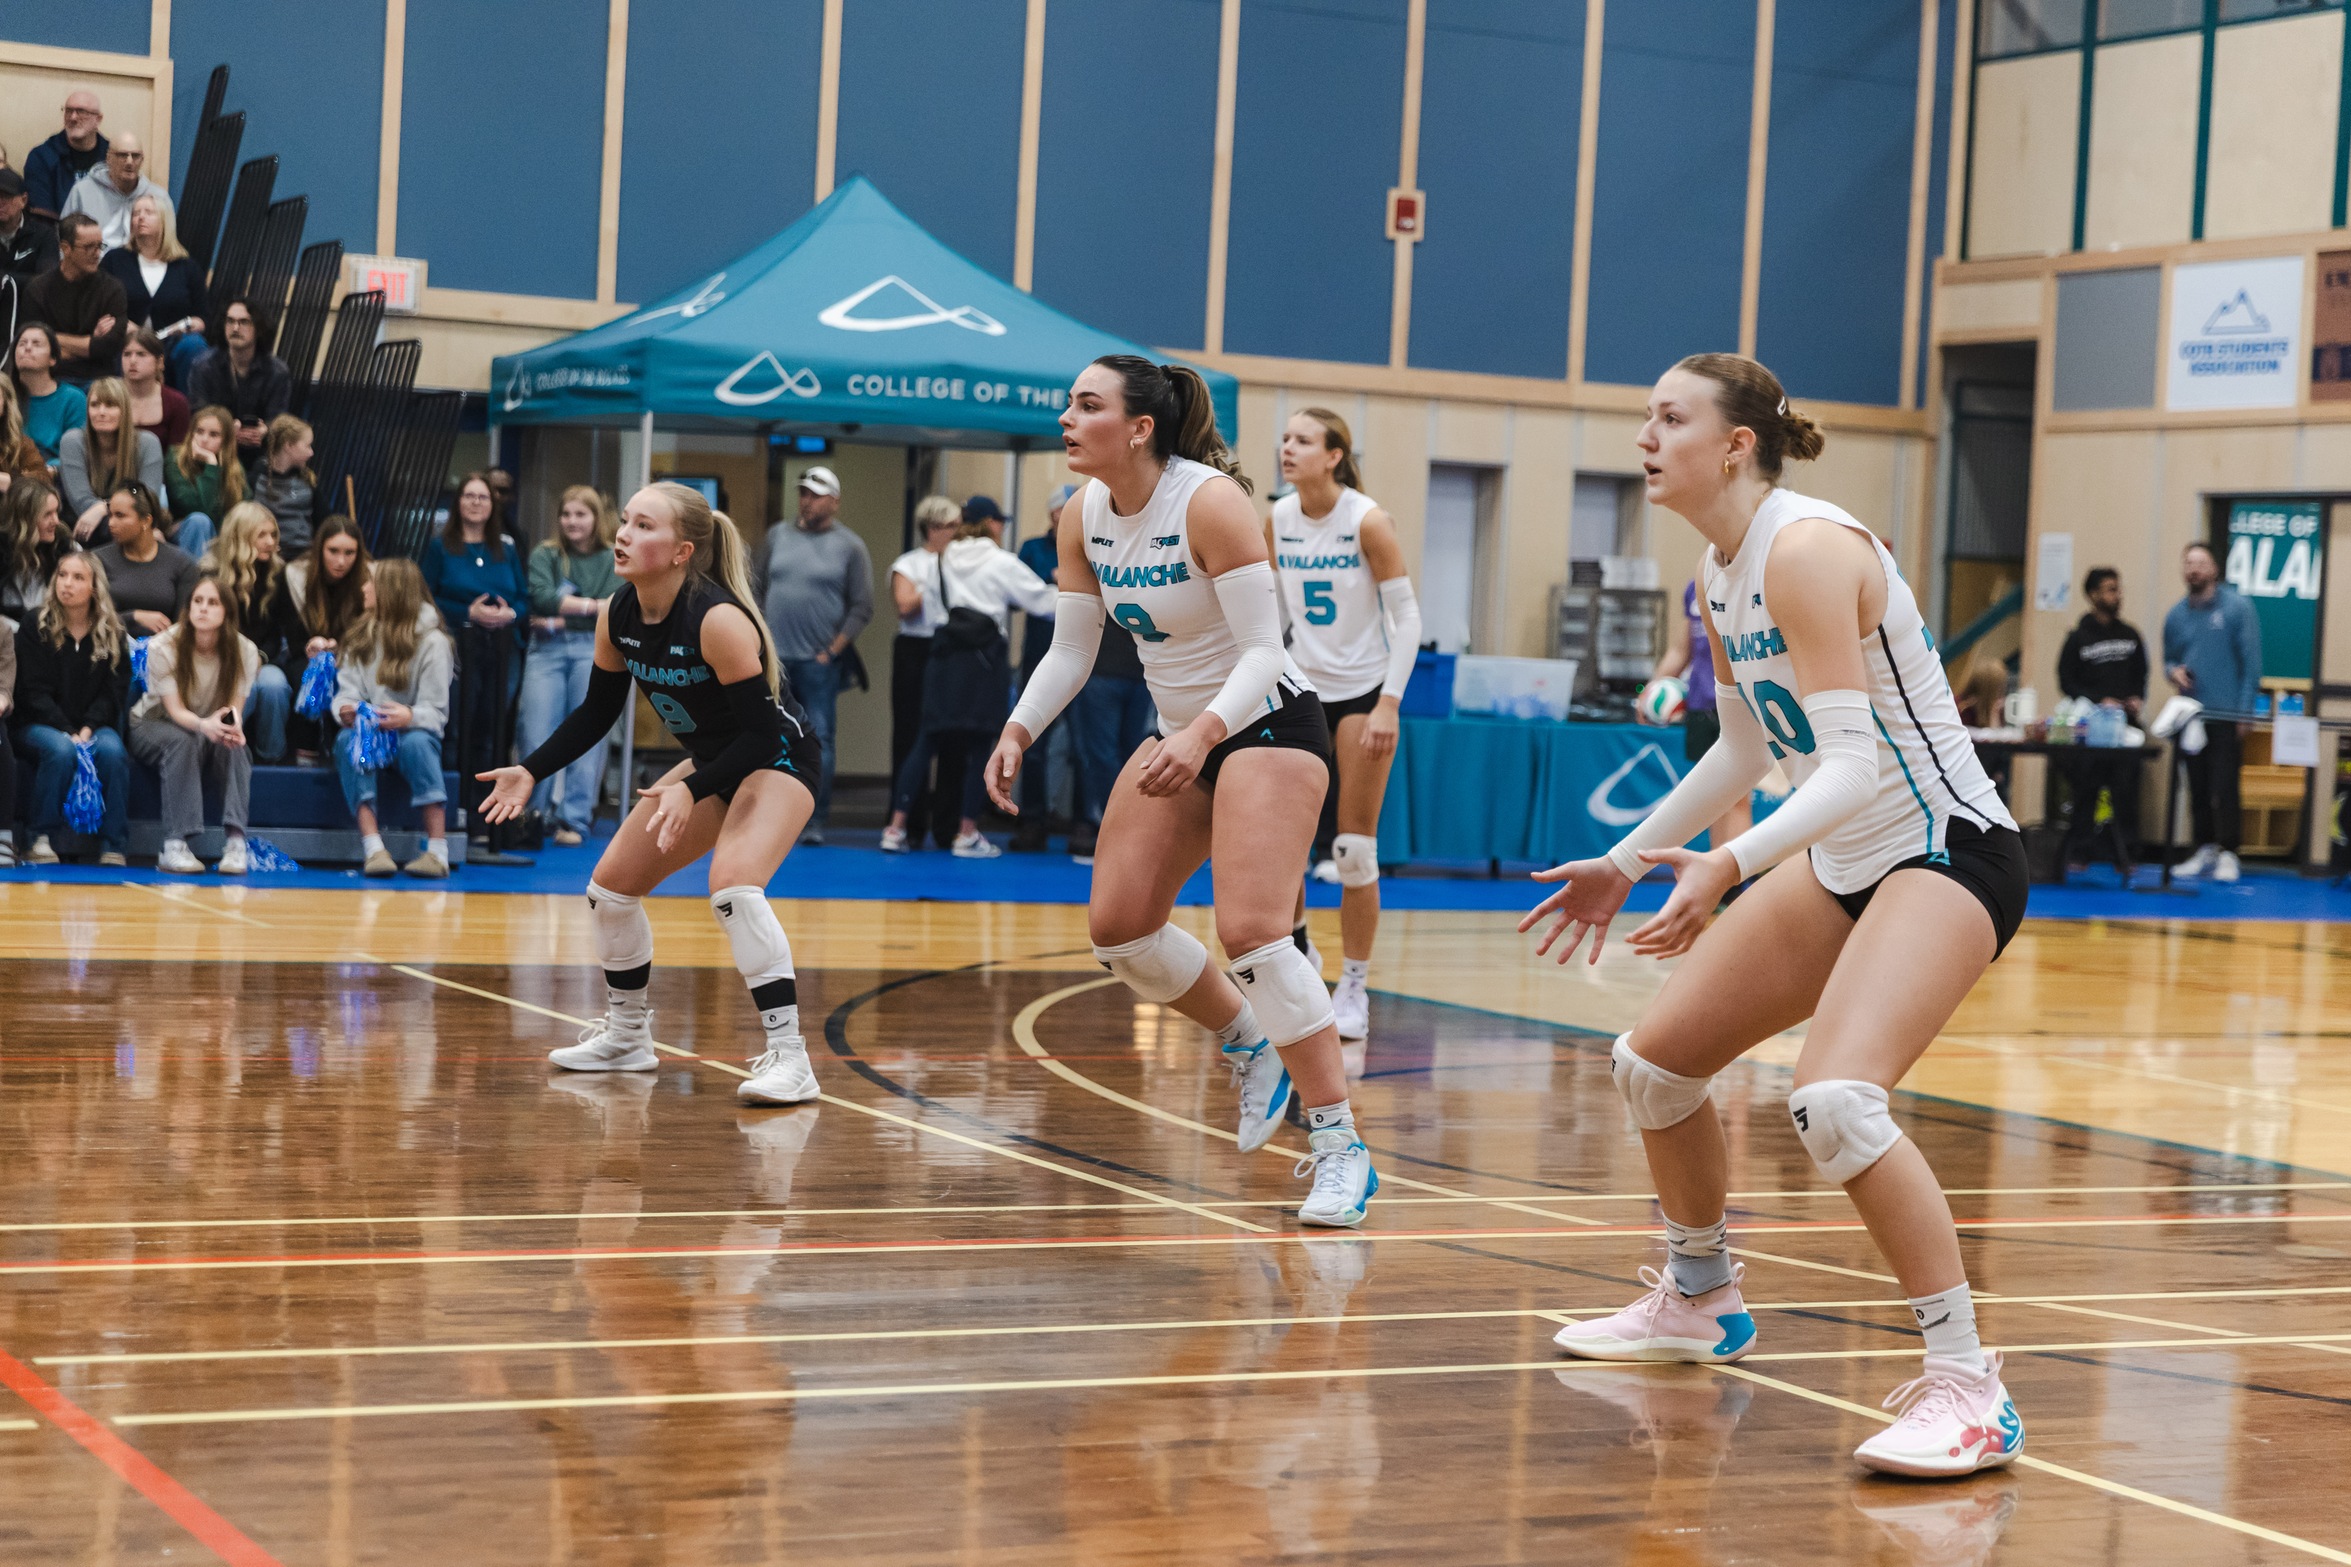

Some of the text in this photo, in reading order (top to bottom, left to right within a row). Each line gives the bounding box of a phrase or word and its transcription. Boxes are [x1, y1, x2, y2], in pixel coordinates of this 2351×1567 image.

[847, 373, 1067, 410] COLLEGE OF THE
[2288, 514, 2319, 538] OF
[1303, 580, 1337, 626] 5
